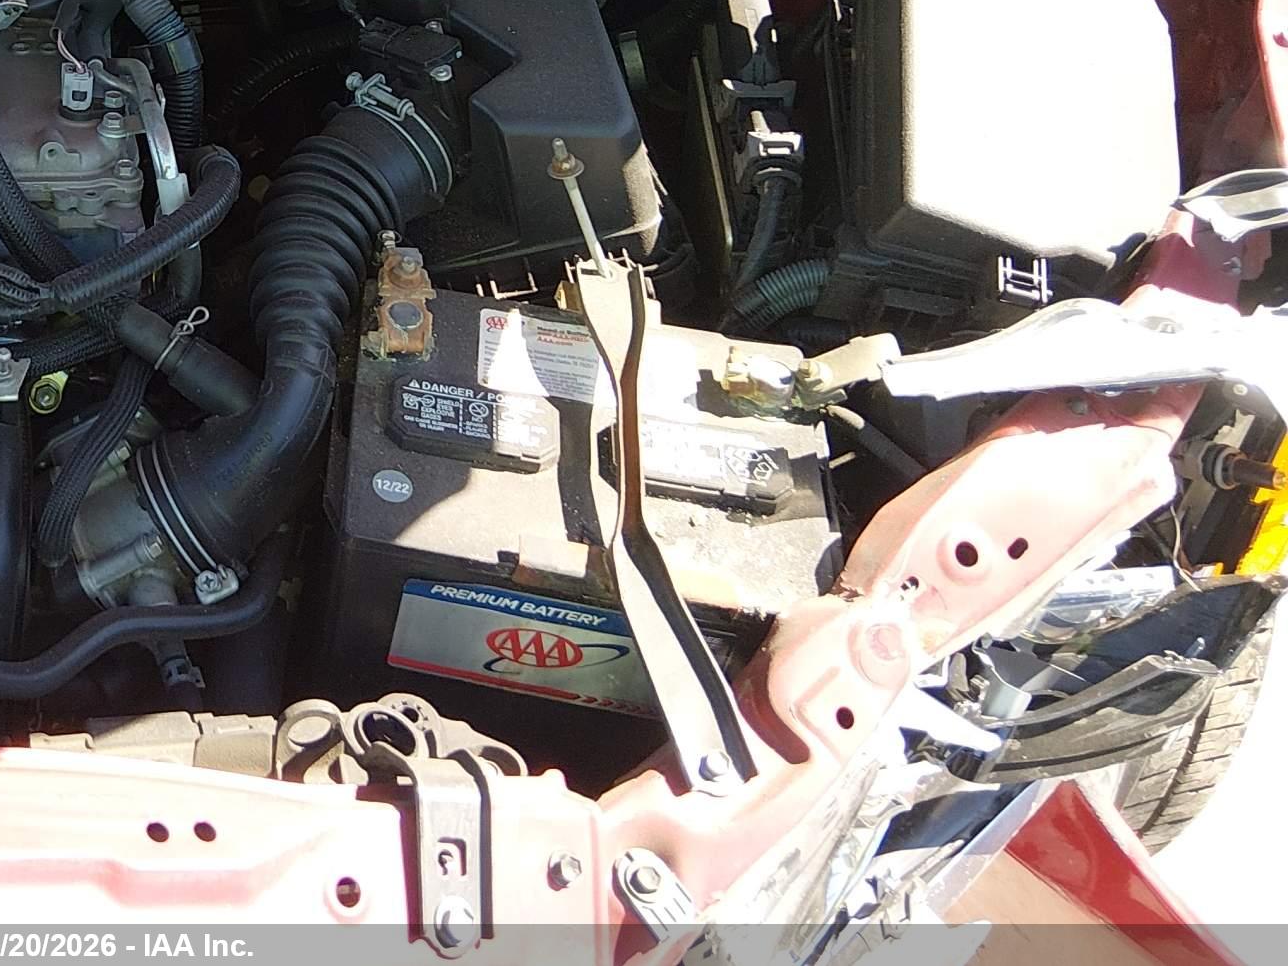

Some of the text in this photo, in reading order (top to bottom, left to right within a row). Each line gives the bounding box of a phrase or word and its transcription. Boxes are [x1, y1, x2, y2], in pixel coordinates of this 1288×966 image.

[421, 380, 474, 399] DANGER
[375, 478, 409, 494] 12/22
[430, 584, 607, 626] PREMIUM BATTERY
[492, 628, 576, 668] AAA
